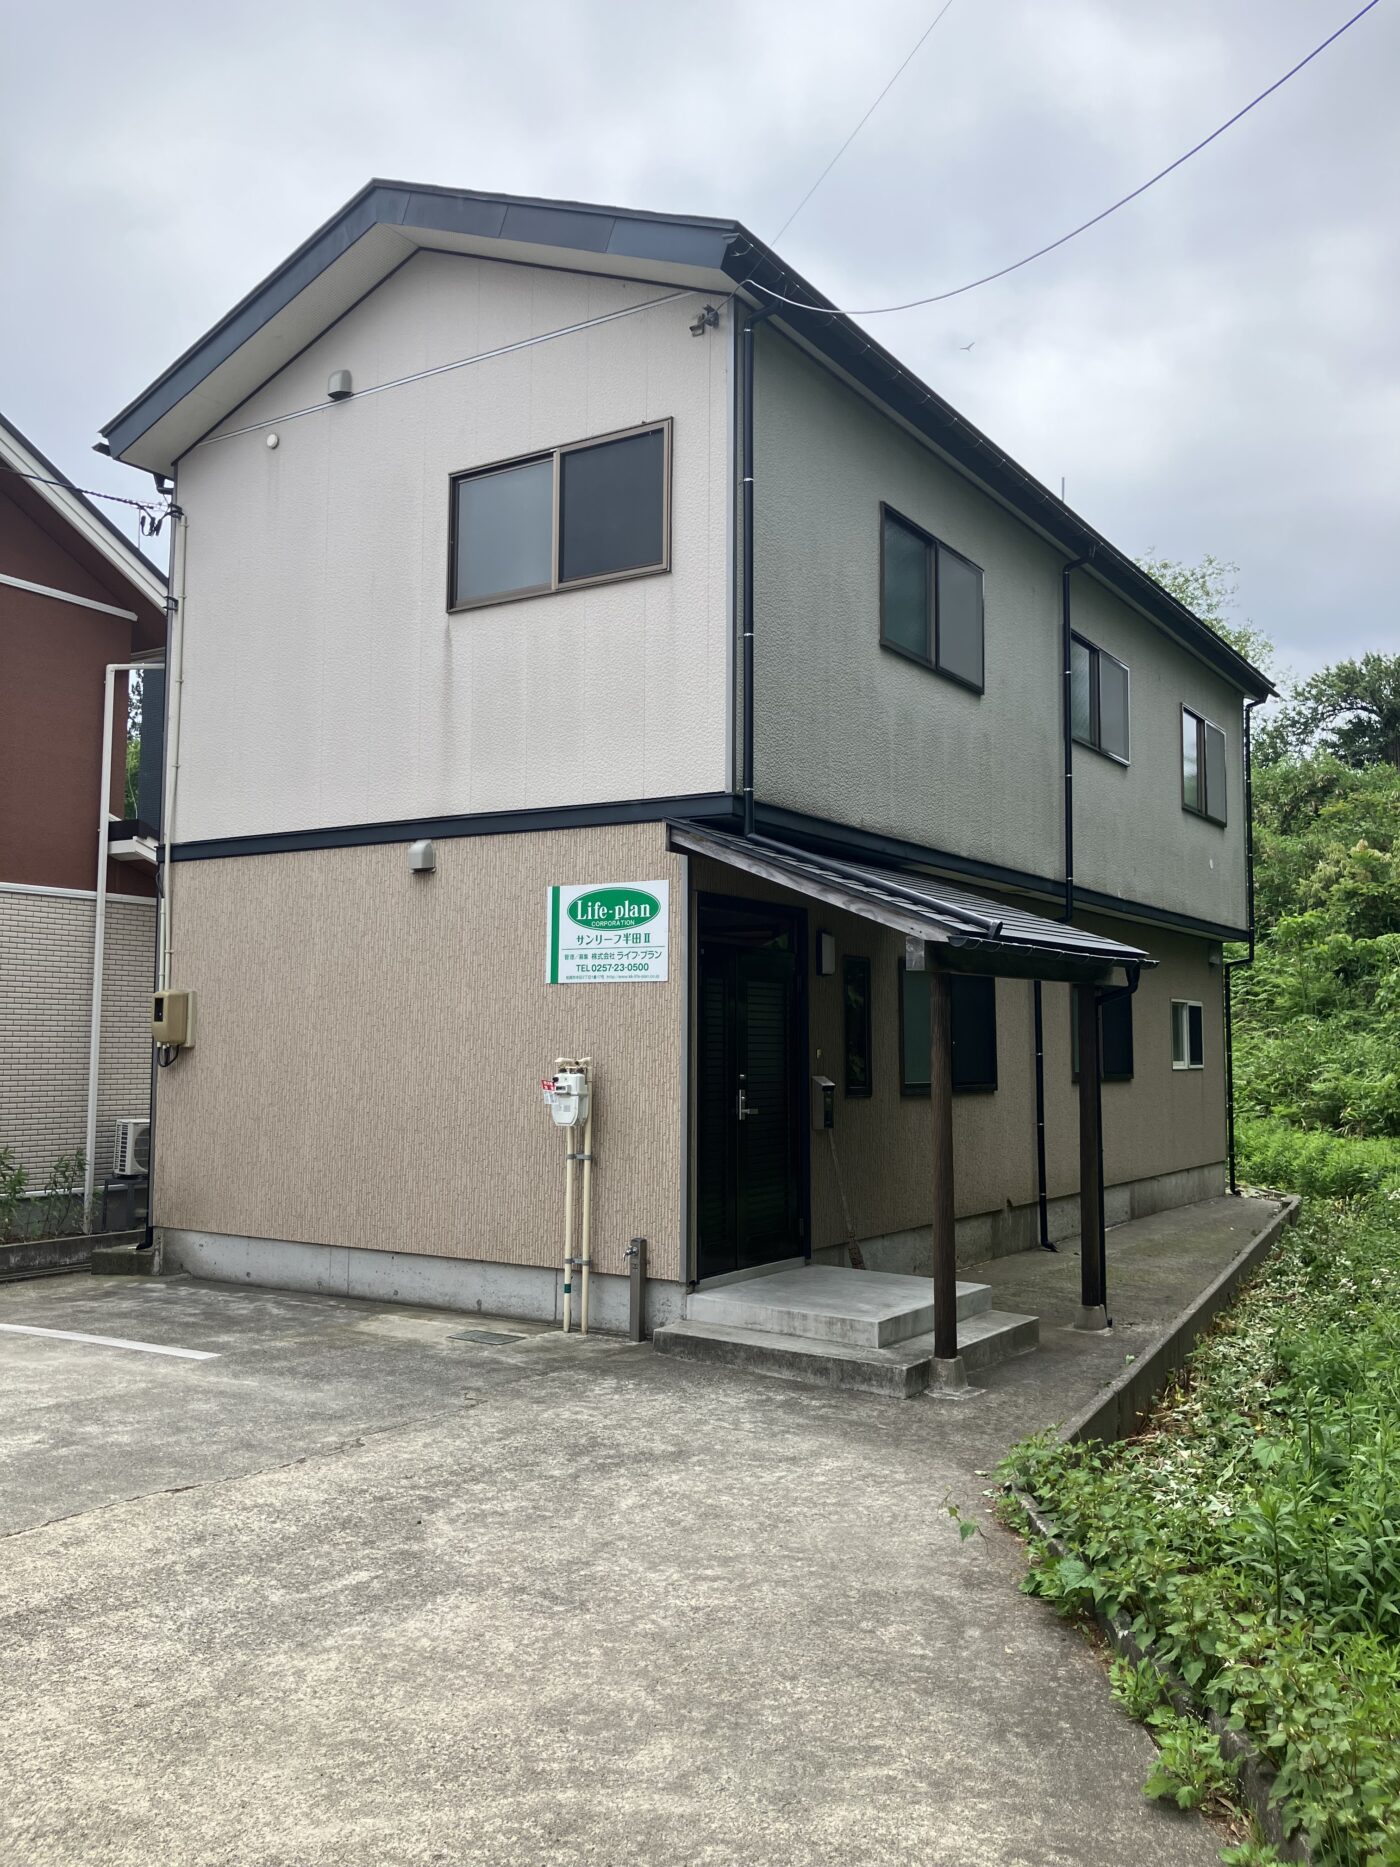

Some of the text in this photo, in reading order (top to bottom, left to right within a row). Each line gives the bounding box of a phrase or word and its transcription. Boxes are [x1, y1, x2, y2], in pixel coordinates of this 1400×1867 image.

[576, 900, 651, 920] Life-plan
[591, 952, 616, 960] 株式会社
[576, 964, 590, 972] TEL
